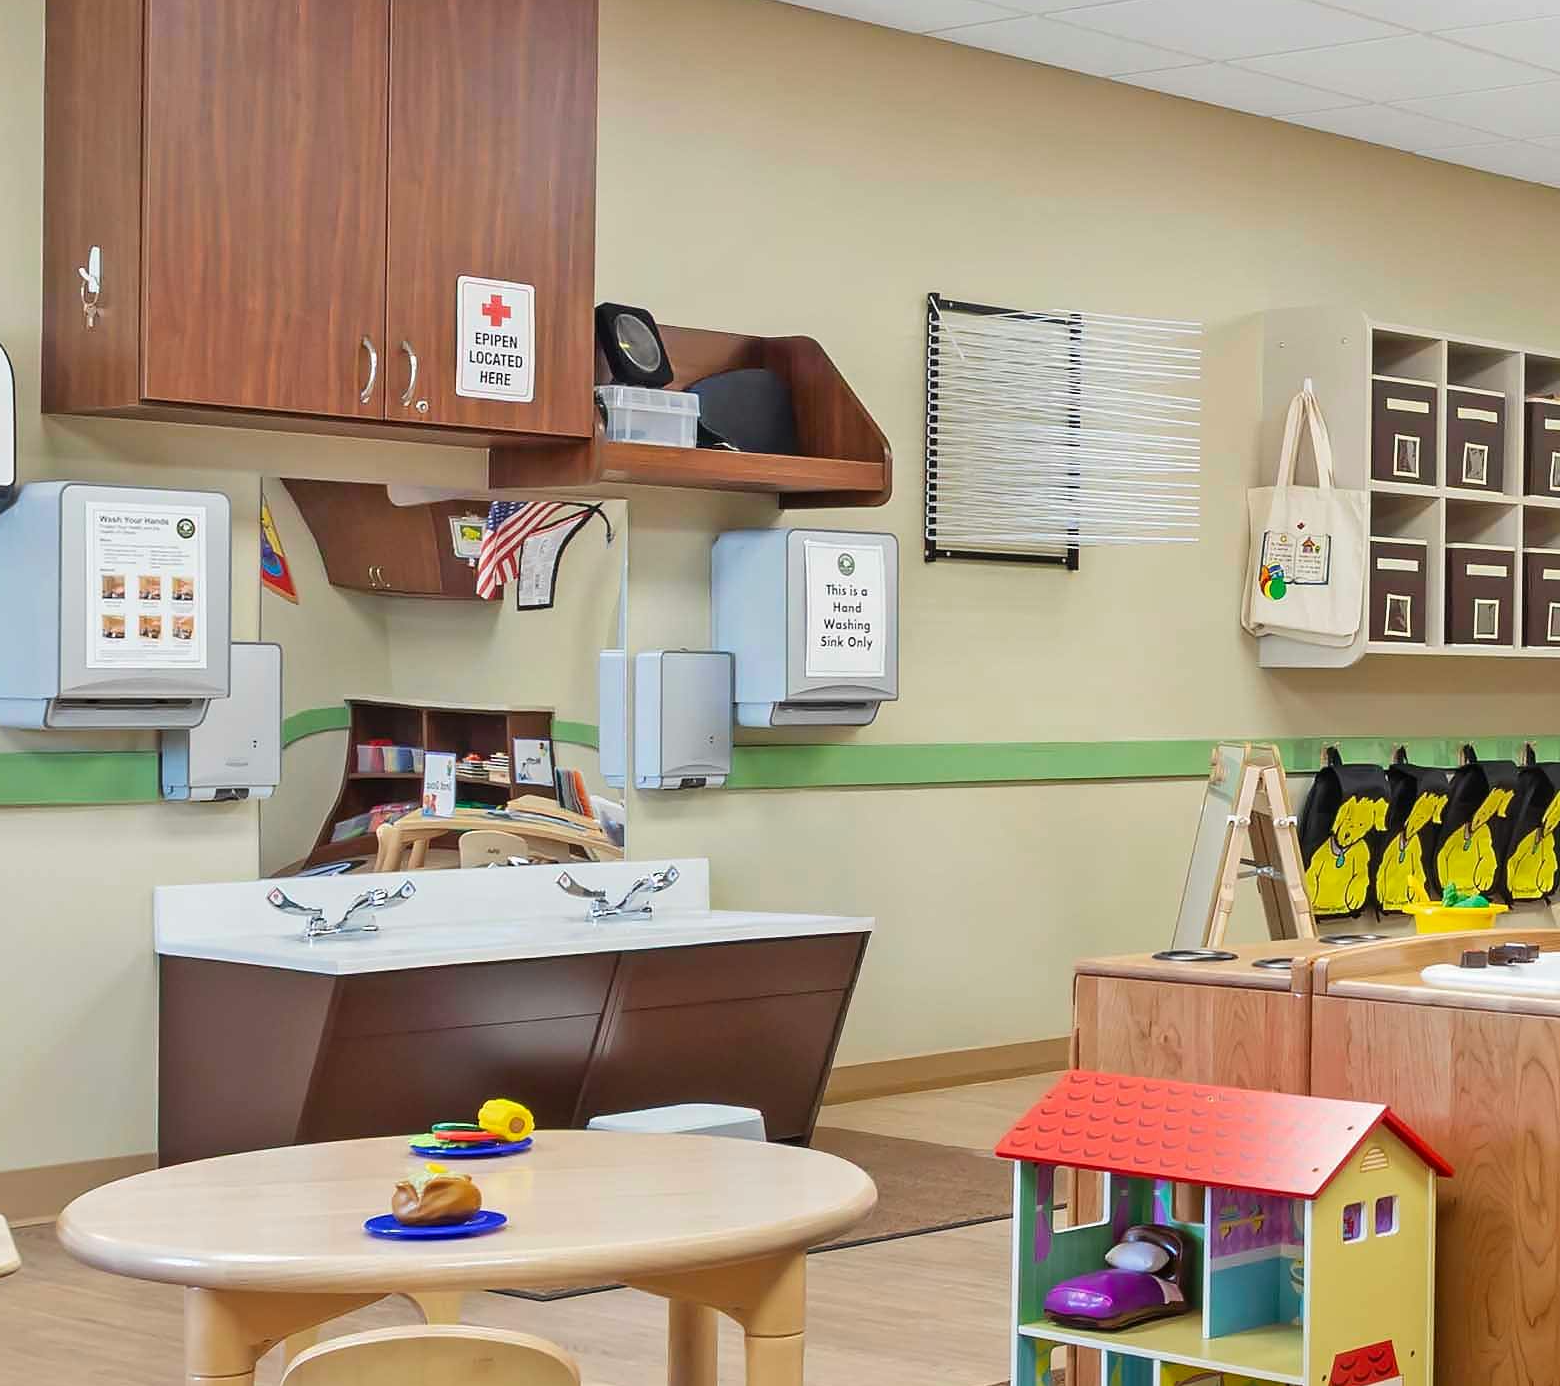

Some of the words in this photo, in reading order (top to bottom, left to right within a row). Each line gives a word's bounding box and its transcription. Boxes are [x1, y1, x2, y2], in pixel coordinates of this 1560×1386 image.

[475, 332, 518, 349] EPIPEN
[469, 350, 523, 368] LOCATED
[480, 371, 511, 386] HERE
[99, 516, 121, 525] Wash
[144, 517, 169, 526] Hands
[826, 584, 847, 596] This
[849, 584, 858, 596] is
[861, 588, 868, 597] a
[833, 601, 862, 613] Hand
[824, 618, 871, 633] Washing
[820, 635, 844, 647] Sink
[847, 636, 873, 651] Only
